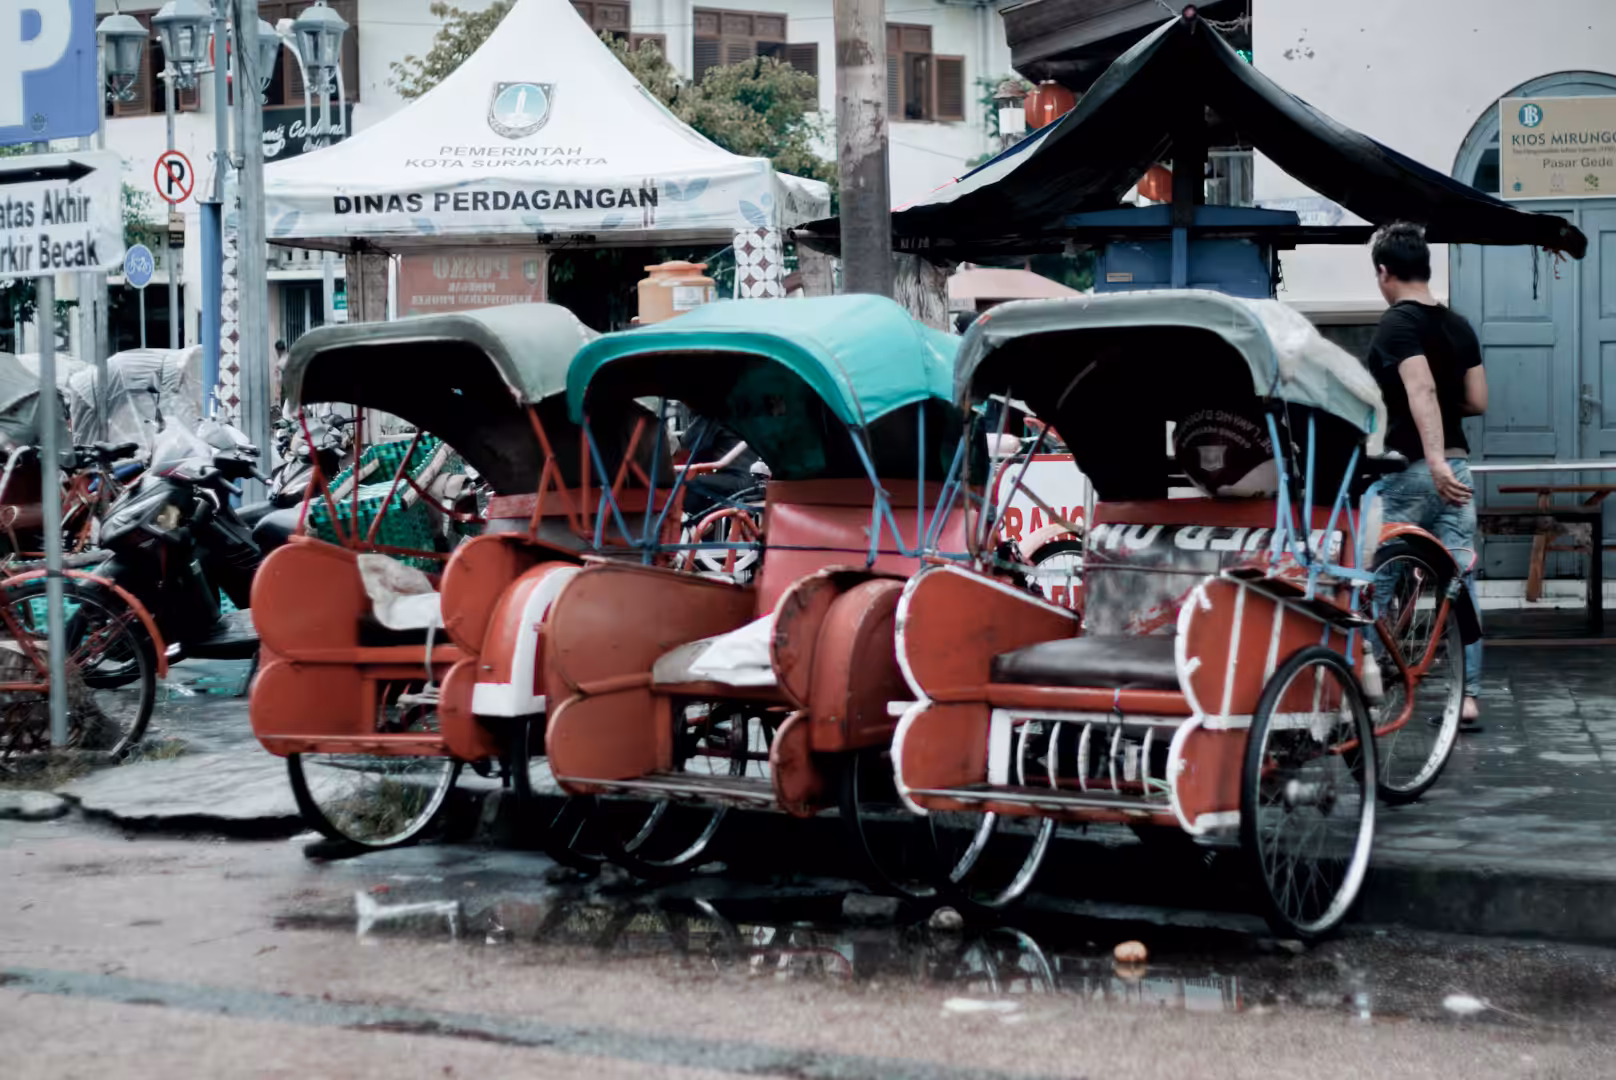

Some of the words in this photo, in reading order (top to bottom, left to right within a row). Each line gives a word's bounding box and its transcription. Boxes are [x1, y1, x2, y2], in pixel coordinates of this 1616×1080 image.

[1512, 133, 1546, 145] KIOS
[439, 146, 582, 156] PEMERINTAH
[404, 158, 464, 168] KOTA
[471, 157, 608, 168] SURAKARTA
[1543, 157, 1577, 169] Pasar
[42, 187, 91, 226] Akhir
[333, 193, 423, 214] DINAS
[434, 187, 659, 212] PERDAGANGAN
[39, 230, 100, 269] Becak
